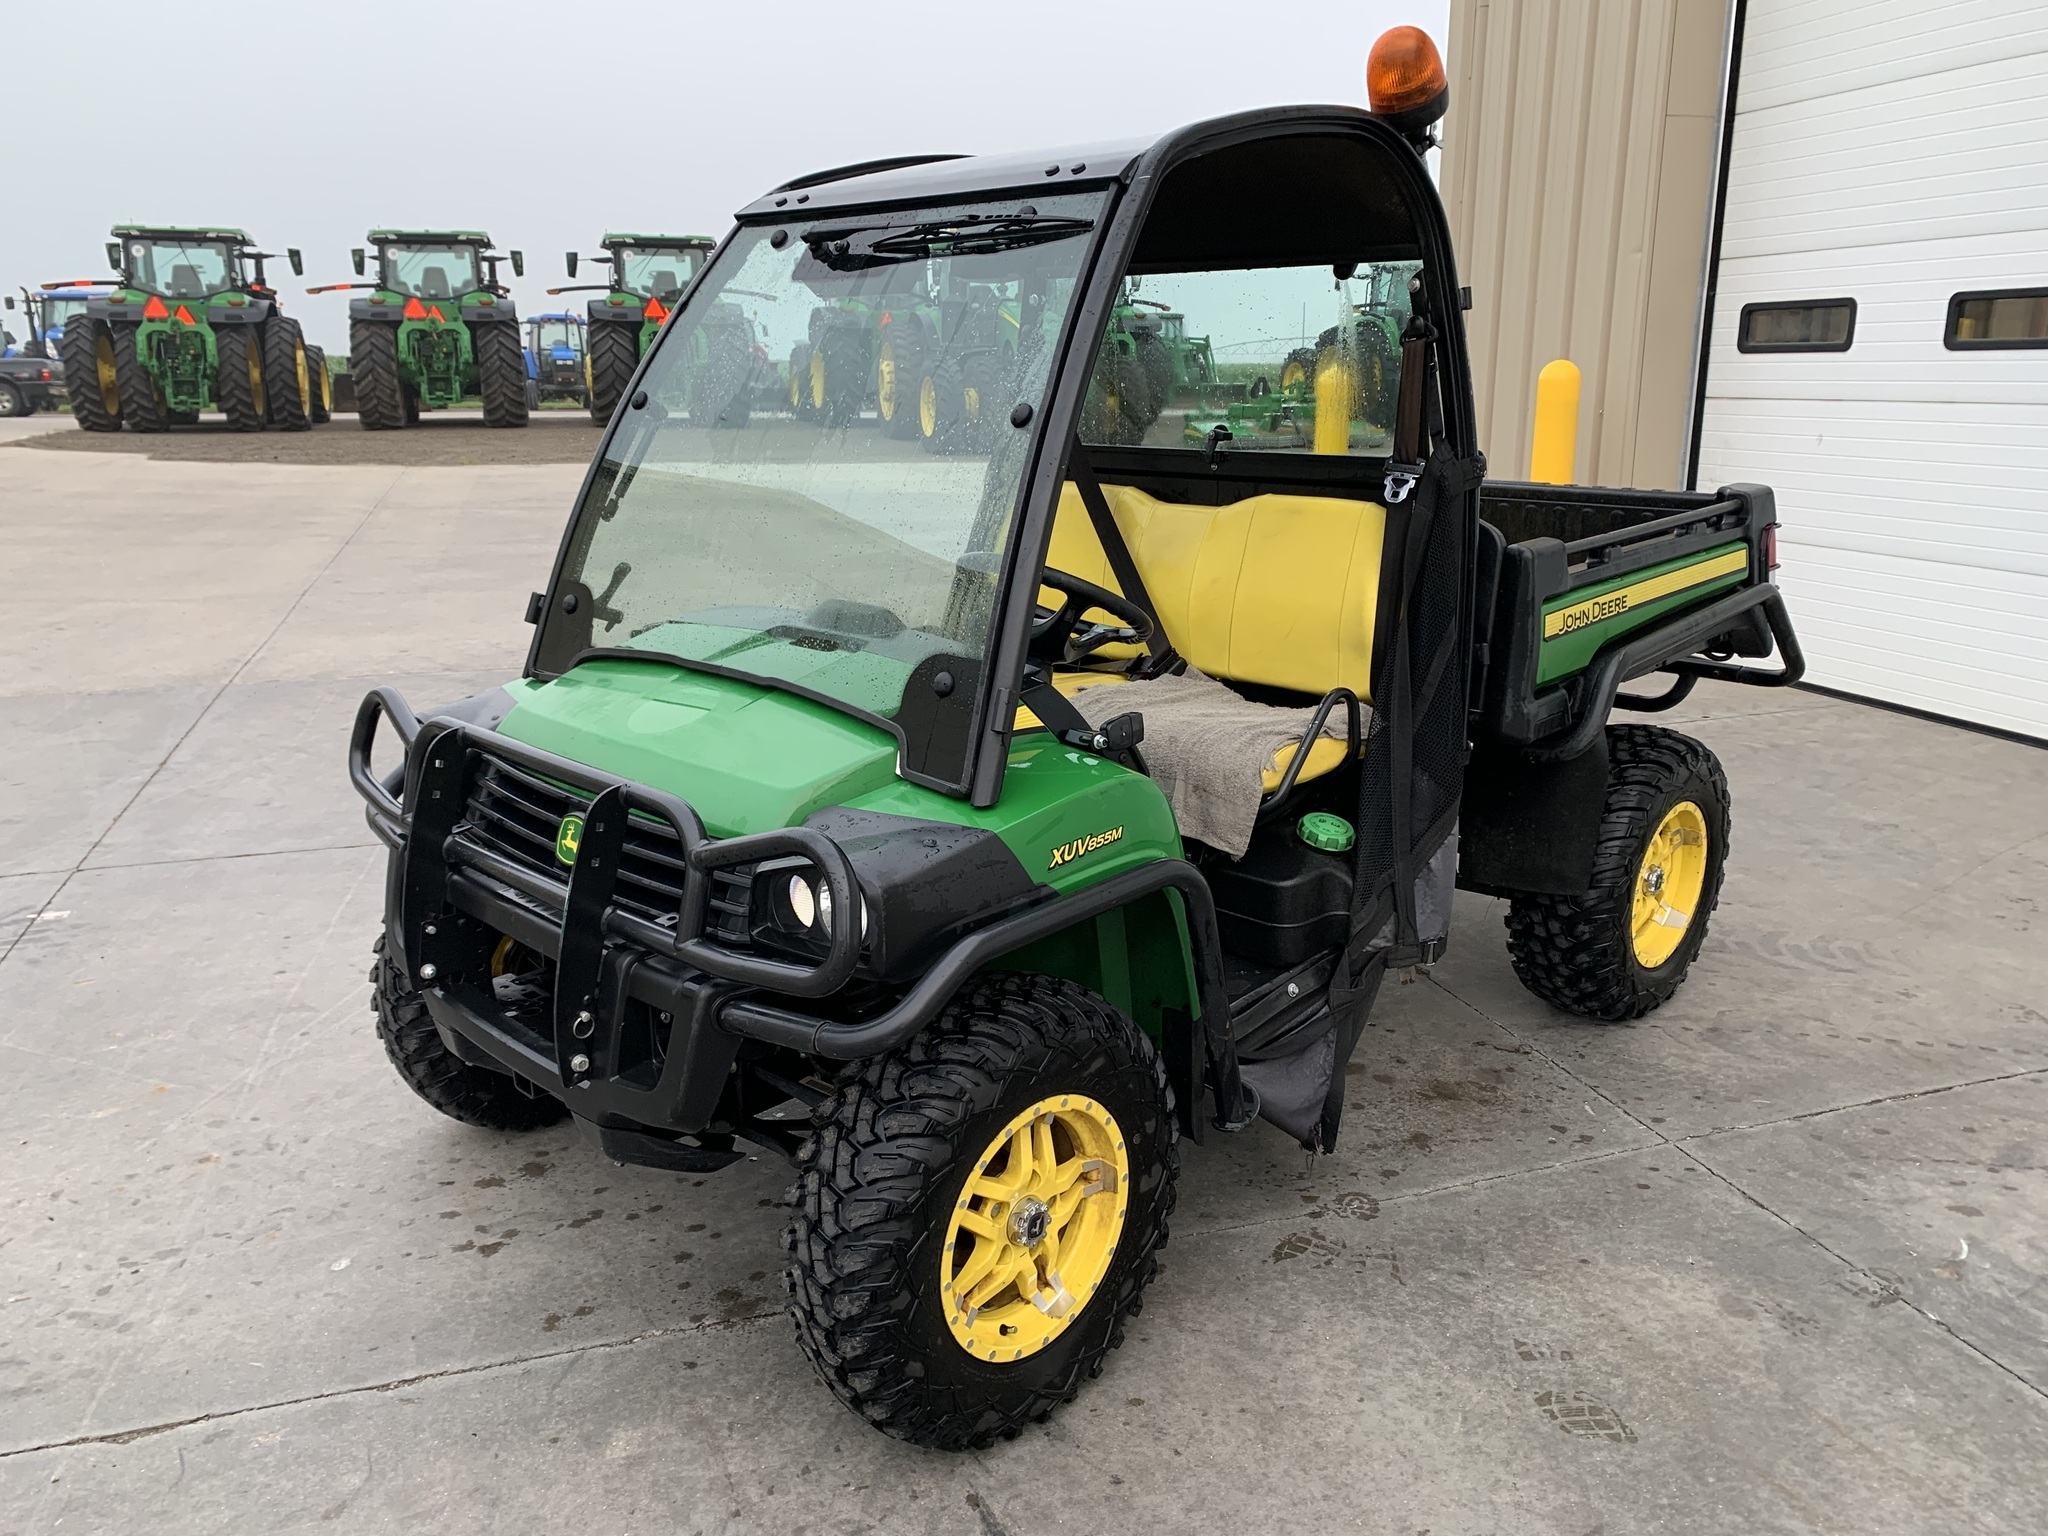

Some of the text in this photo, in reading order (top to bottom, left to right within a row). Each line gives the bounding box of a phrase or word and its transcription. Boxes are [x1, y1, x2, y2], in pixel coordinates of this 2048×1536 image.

[1558, 594, 1628, 633] JOHN DEERE
[1049, 825, 1123, 870] XUV855M
